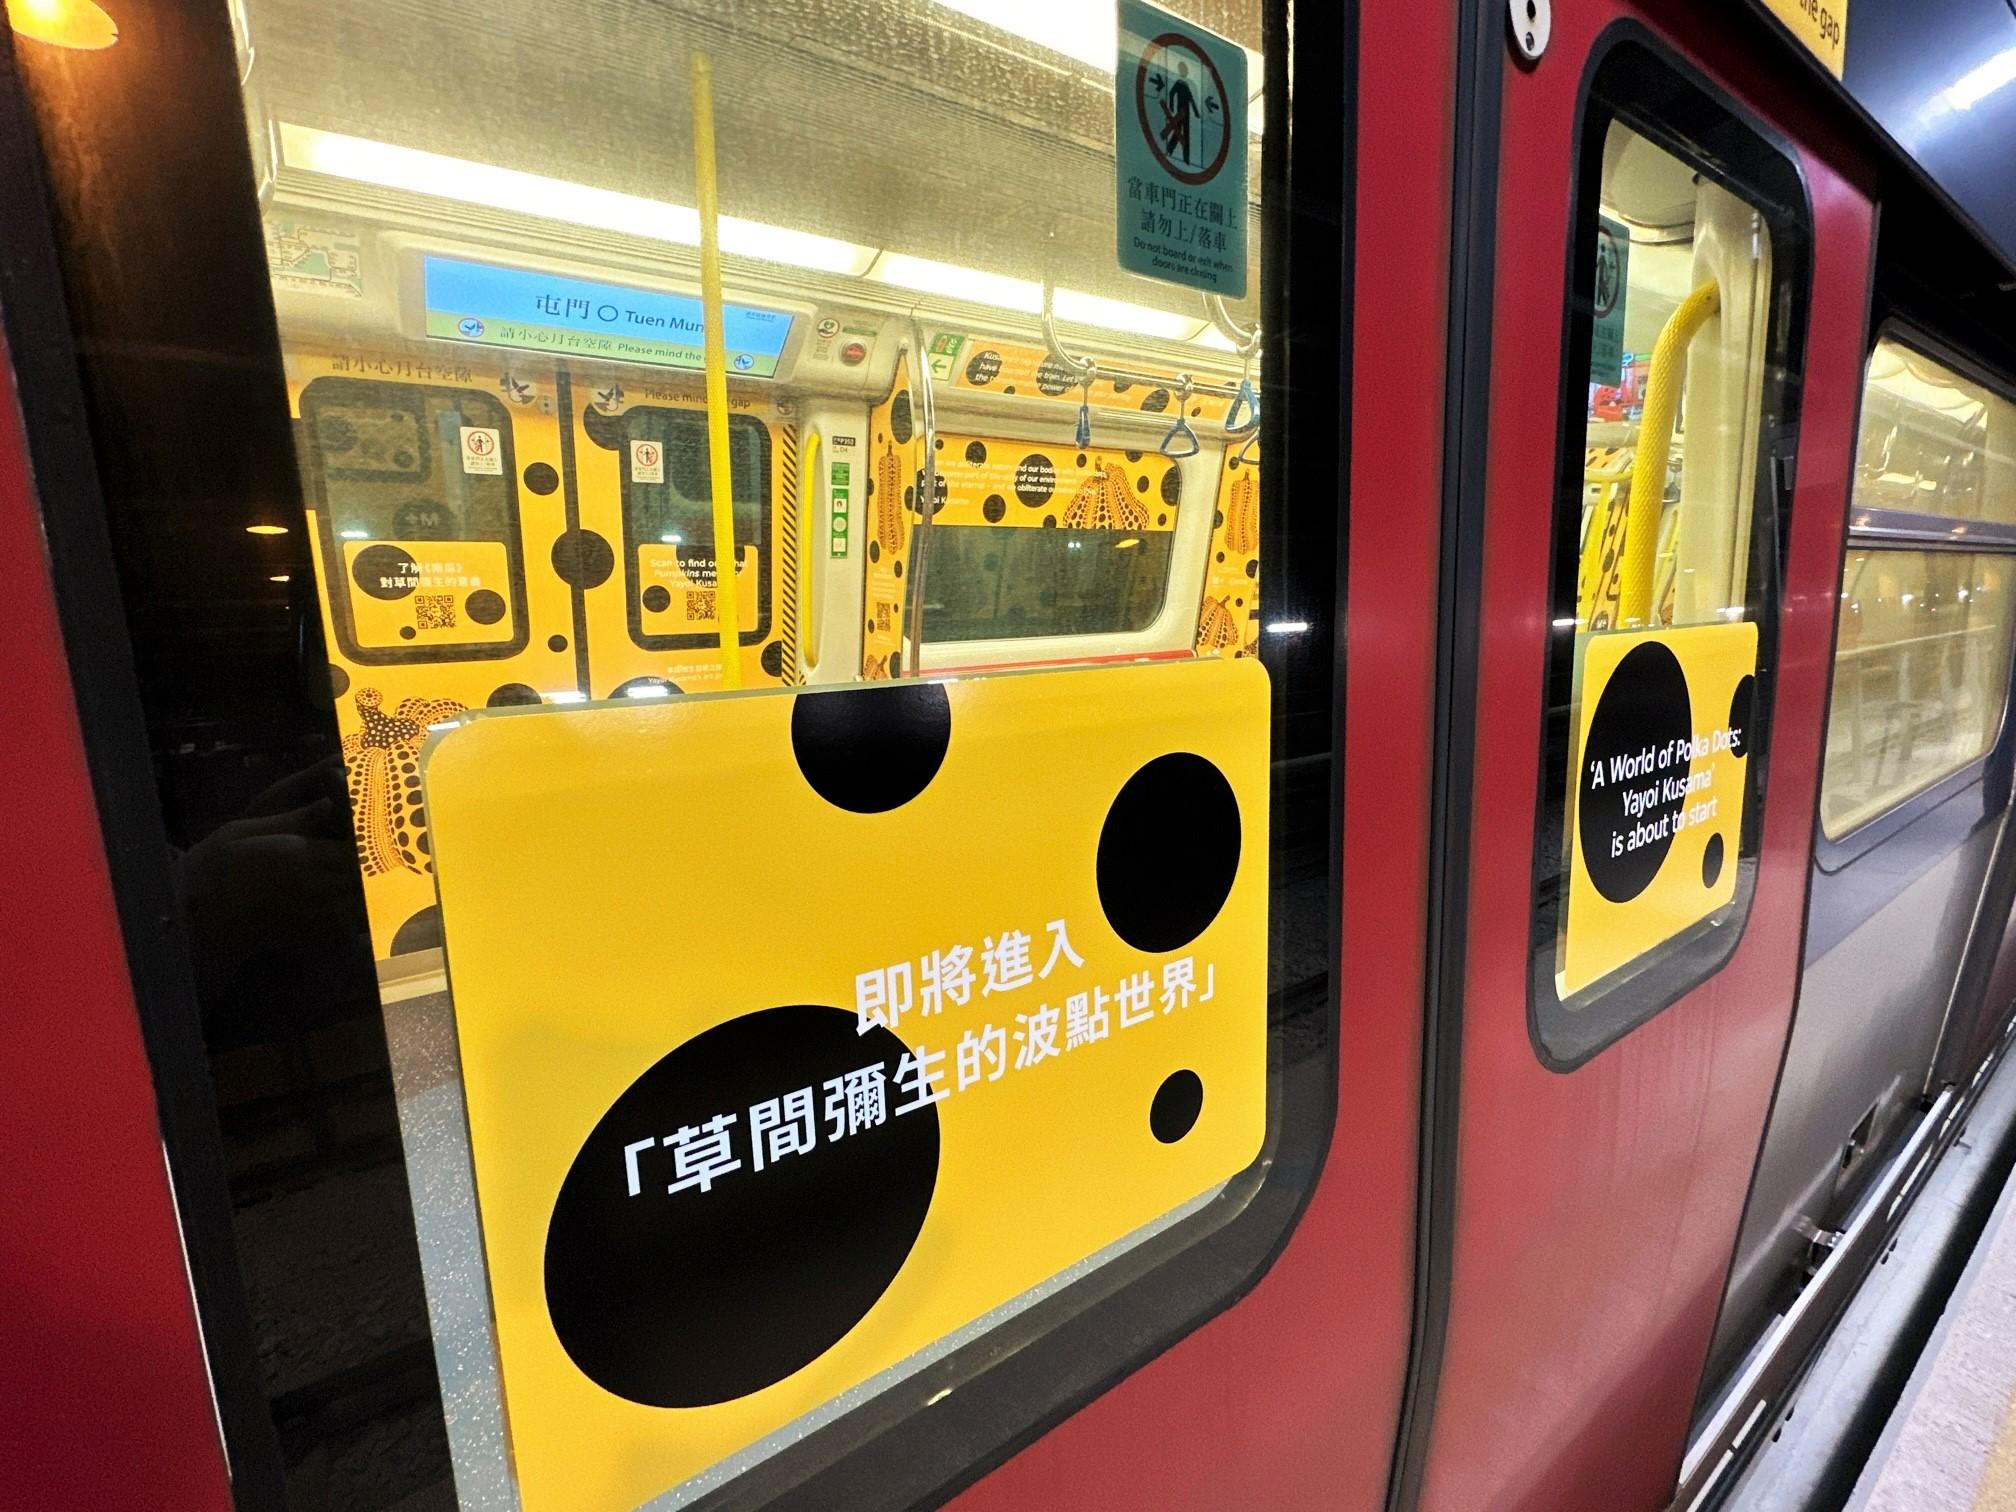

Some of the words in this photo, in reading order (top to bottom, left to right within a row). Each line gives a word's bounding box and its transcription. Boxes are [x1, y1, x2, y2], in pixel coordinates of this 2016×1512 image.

[1819, 7, 1840, 50] gap
[1127, 175, 1238, 230] 當車門正在關上
[1140, 208, 1227, 253] 請勿上/落車
[1133, 236, 1146, 250] Do
[1146, 240, 1160, 254] not
[1162, 243, 1187, 261] board
[1188, 253, 1197, 263] or
[1152, 255, 1176, 272] doors
[1176, 263, 1189, 276] are
[1190, 265, 1217, 283] closing
[535, 294, 591, 321] 屯門
[625, 310, 666, 329] Tuen
[669, 316, 704, 334] Mun
[499, 327, 613, 351] 請小心月台空隙
[617, 342, 653, 357] Please
[655, 348, 683, 361] mind
[685, 350, 702, 362] the
[644, 387, 680, 402] Please
[731, 398, 751, 410] gap
[687, 558, 707, 568] find
[1610, 744, 1656, 784] World
[1657, 740, 1675, 770] of
[1675, 734, 1710, 766] Polka
[1622, 780, 1659, 818] Yayoi
[1610, 830, 1624, 858] is
[1627, 813, 1669, 852] about
[1671, 809, 1687, 831] to
[1688, 798, 1719, 825] start
[853, 917, 1086, 1038] 即將進入
[623, 956, 1217, 1197] 「草間彌生的波點世界」
